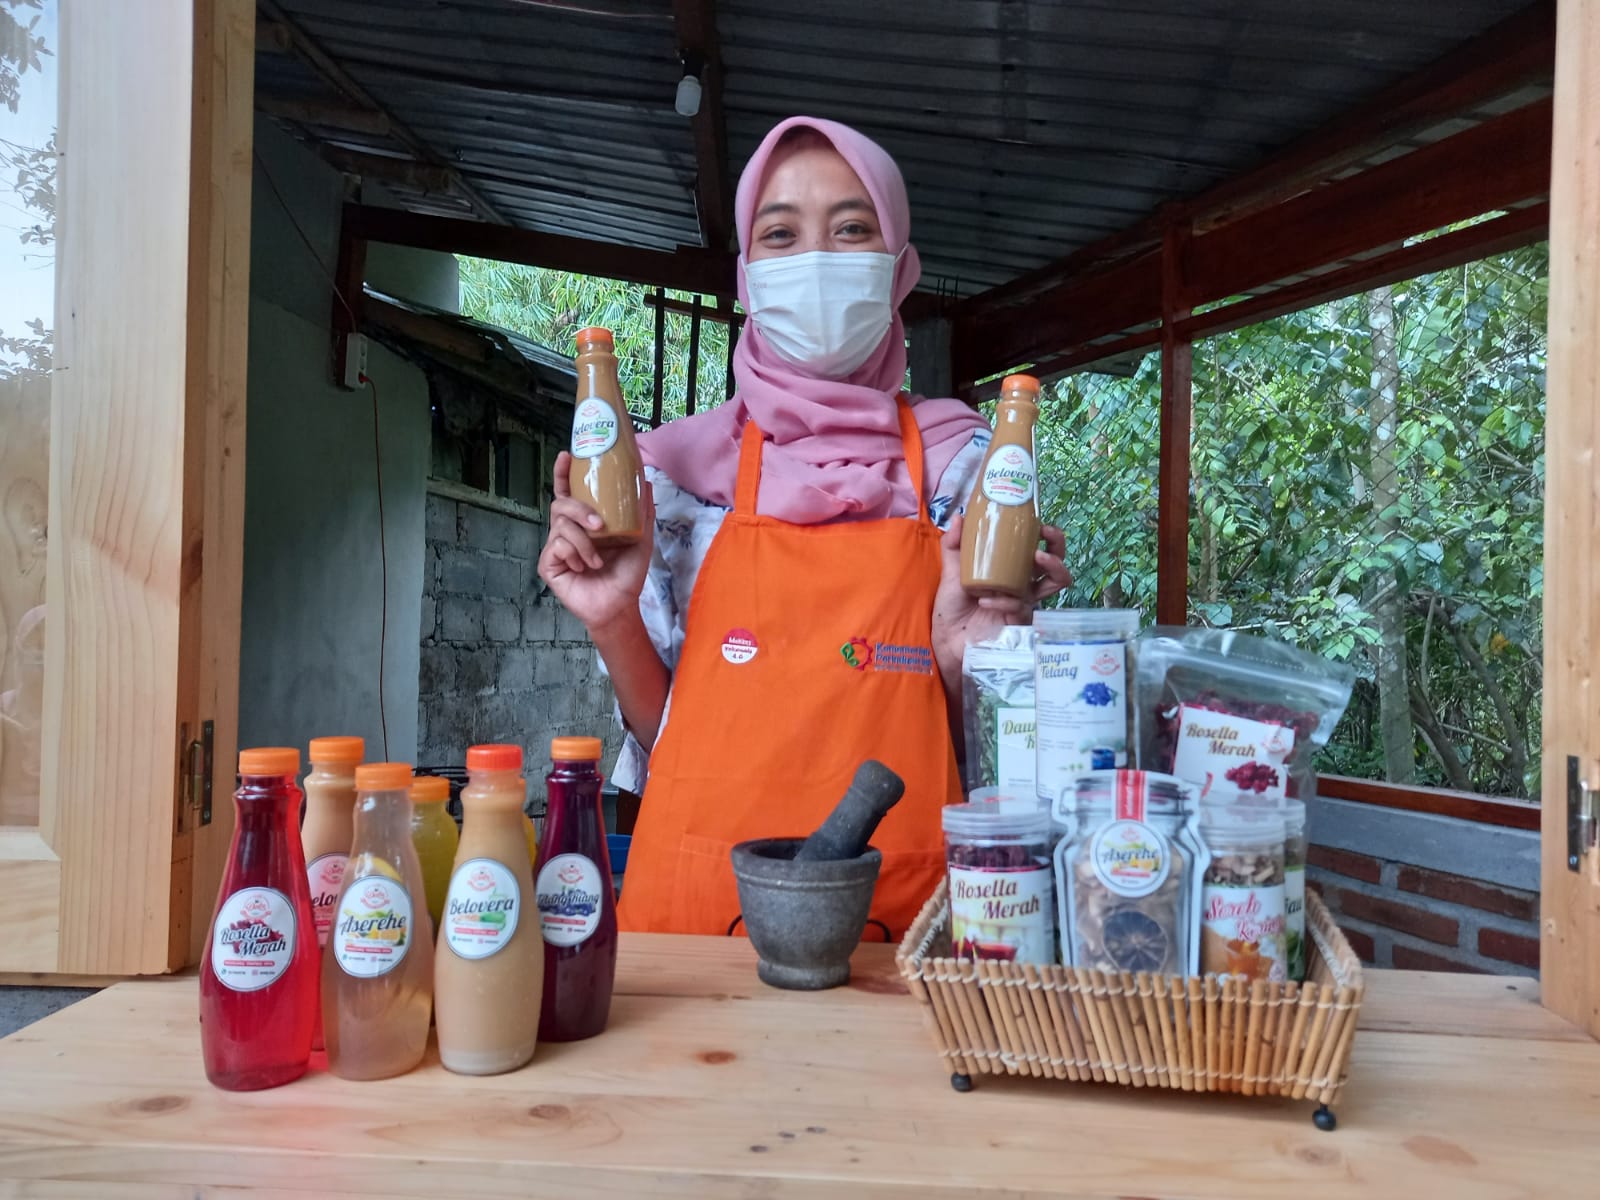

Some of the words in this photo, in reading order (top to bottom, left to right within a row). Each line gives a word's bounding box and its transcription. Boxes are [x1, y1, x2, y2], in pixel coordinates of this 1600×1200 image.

[986, 468, 1033, 482] Belovera
[1041, 666, 1078, 680] Telang
[1186, 723, 1239, 741] Rosella
[1209, 740, 1256, 757] Merah
[956, 879, 1018, 899] Rosella
[450, 897, 514, 915] Belovera
[983, 894, 1041, 920] Merah
[340, 908, 407, 936] Aserehe
[220, 924, 271, 943] Rosella
[239, 939, 287, 957] Merah
